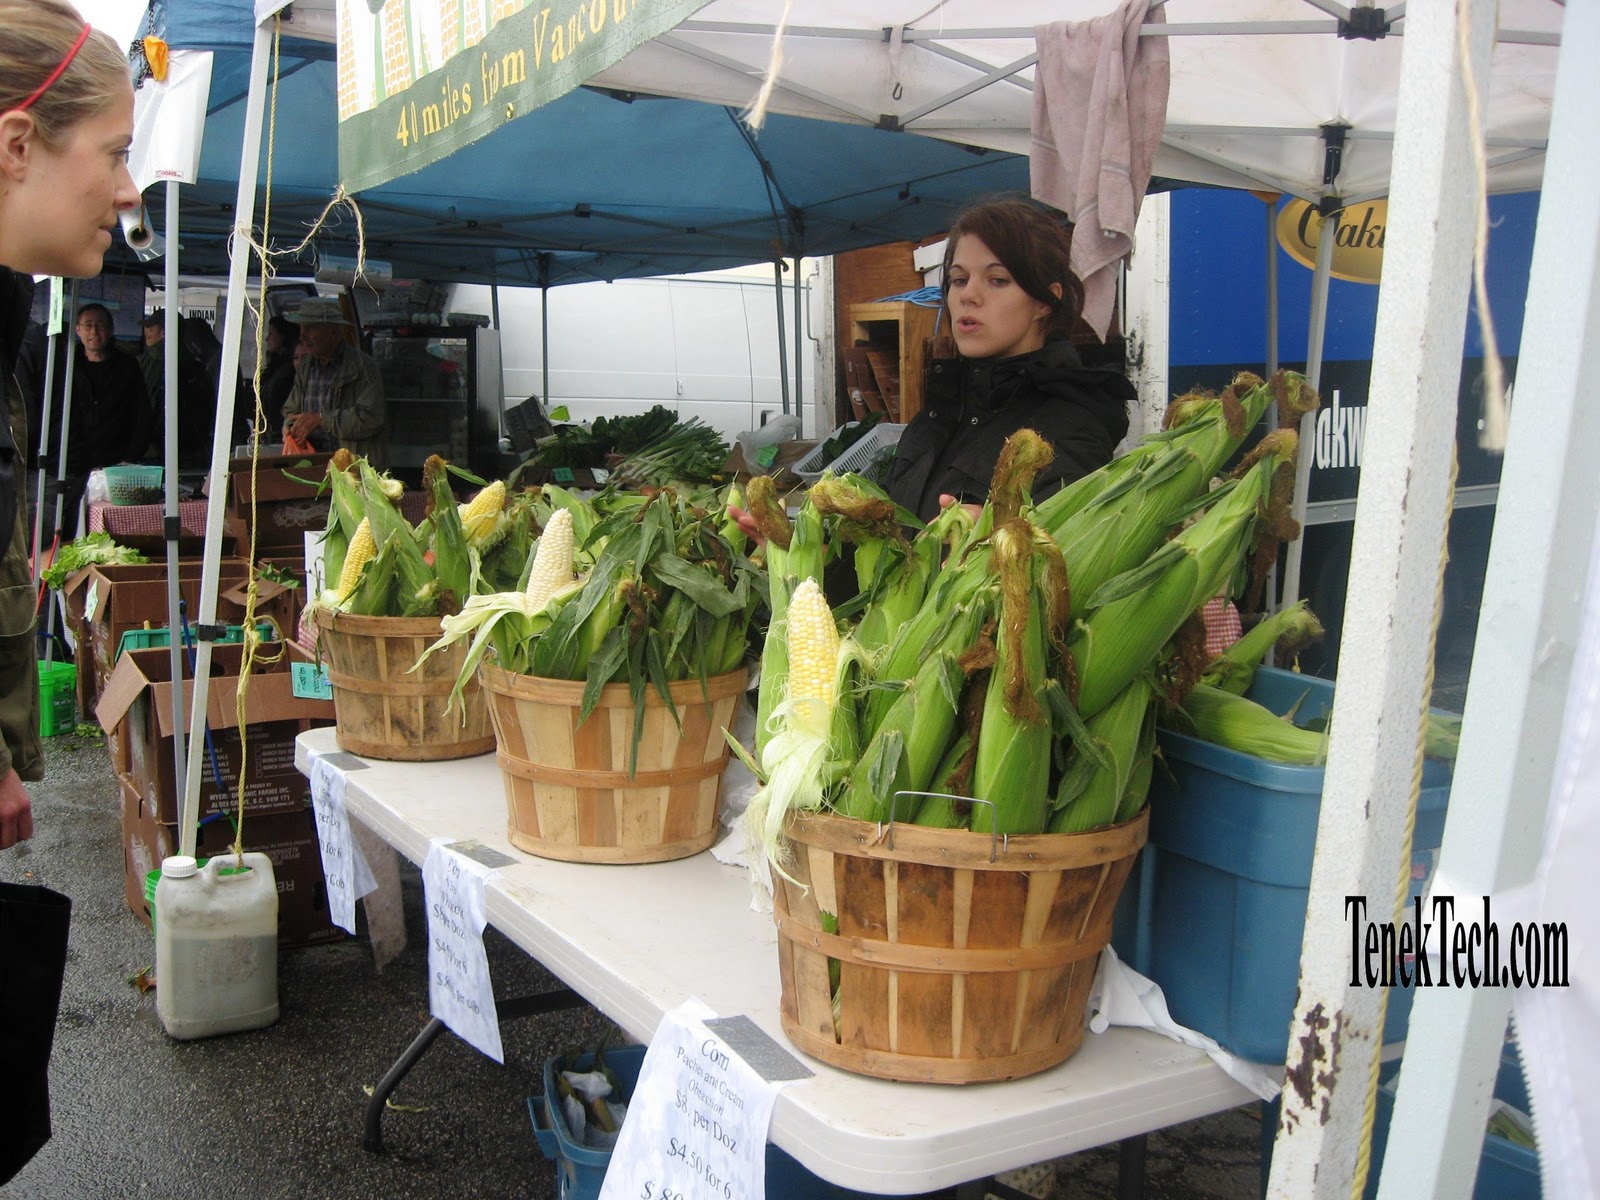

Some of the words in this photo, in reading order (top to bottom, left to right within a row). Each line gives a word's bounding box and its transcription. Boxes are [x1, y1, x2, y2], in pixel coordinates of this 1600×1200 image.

[396, 101, 419, 147] 40
[422, 75, 472, 136] miles
[481, 49, 526, 106] from
[532, 0, 637, 70] Vancou
[189, 310, 215, 320] INDIAN
[330, 874, 345, 889] Cob
[677, 1046, 703, 1078] Peaches
[704, 1072, 719, 1089] and
[719, 1081, 744, 1110] Cream
[689, 1079, 724, 1116] Obsession
[693, 1109, 710, 1132] per
[713, 1121, 736, 1154] Doz
[667, 1137, 703, 1175] $4.50
[705, 1165, 721, 1191] for
[724, 1182, 731, 1200] 6
